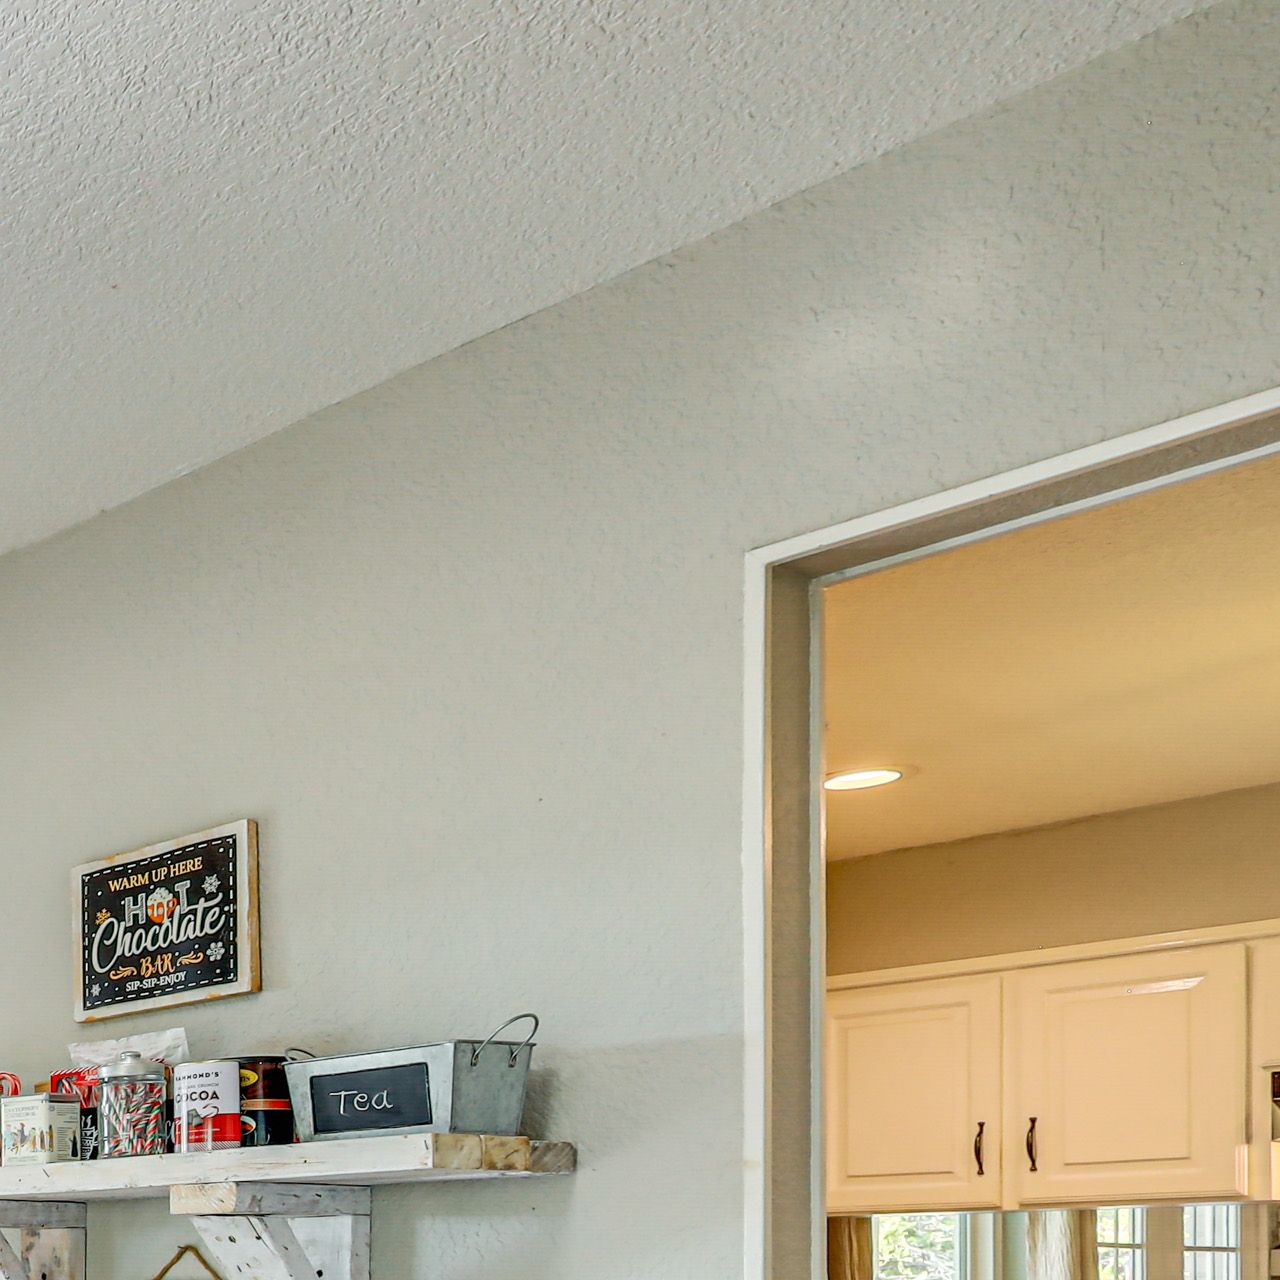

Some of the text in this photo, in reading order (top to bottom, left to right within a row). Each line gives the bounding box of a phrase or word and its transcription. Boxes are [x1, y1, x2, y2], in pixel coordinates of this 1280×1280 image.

[108, 856, 204, 893] WARM UP HERE
[91, 892, 227, 974] Chocolate
[139, 952, 176, 978] BAR
[125, 970, 188, 993] SIP-SIP-ENJOY
[328, 1088, 394, 1117] Tea
